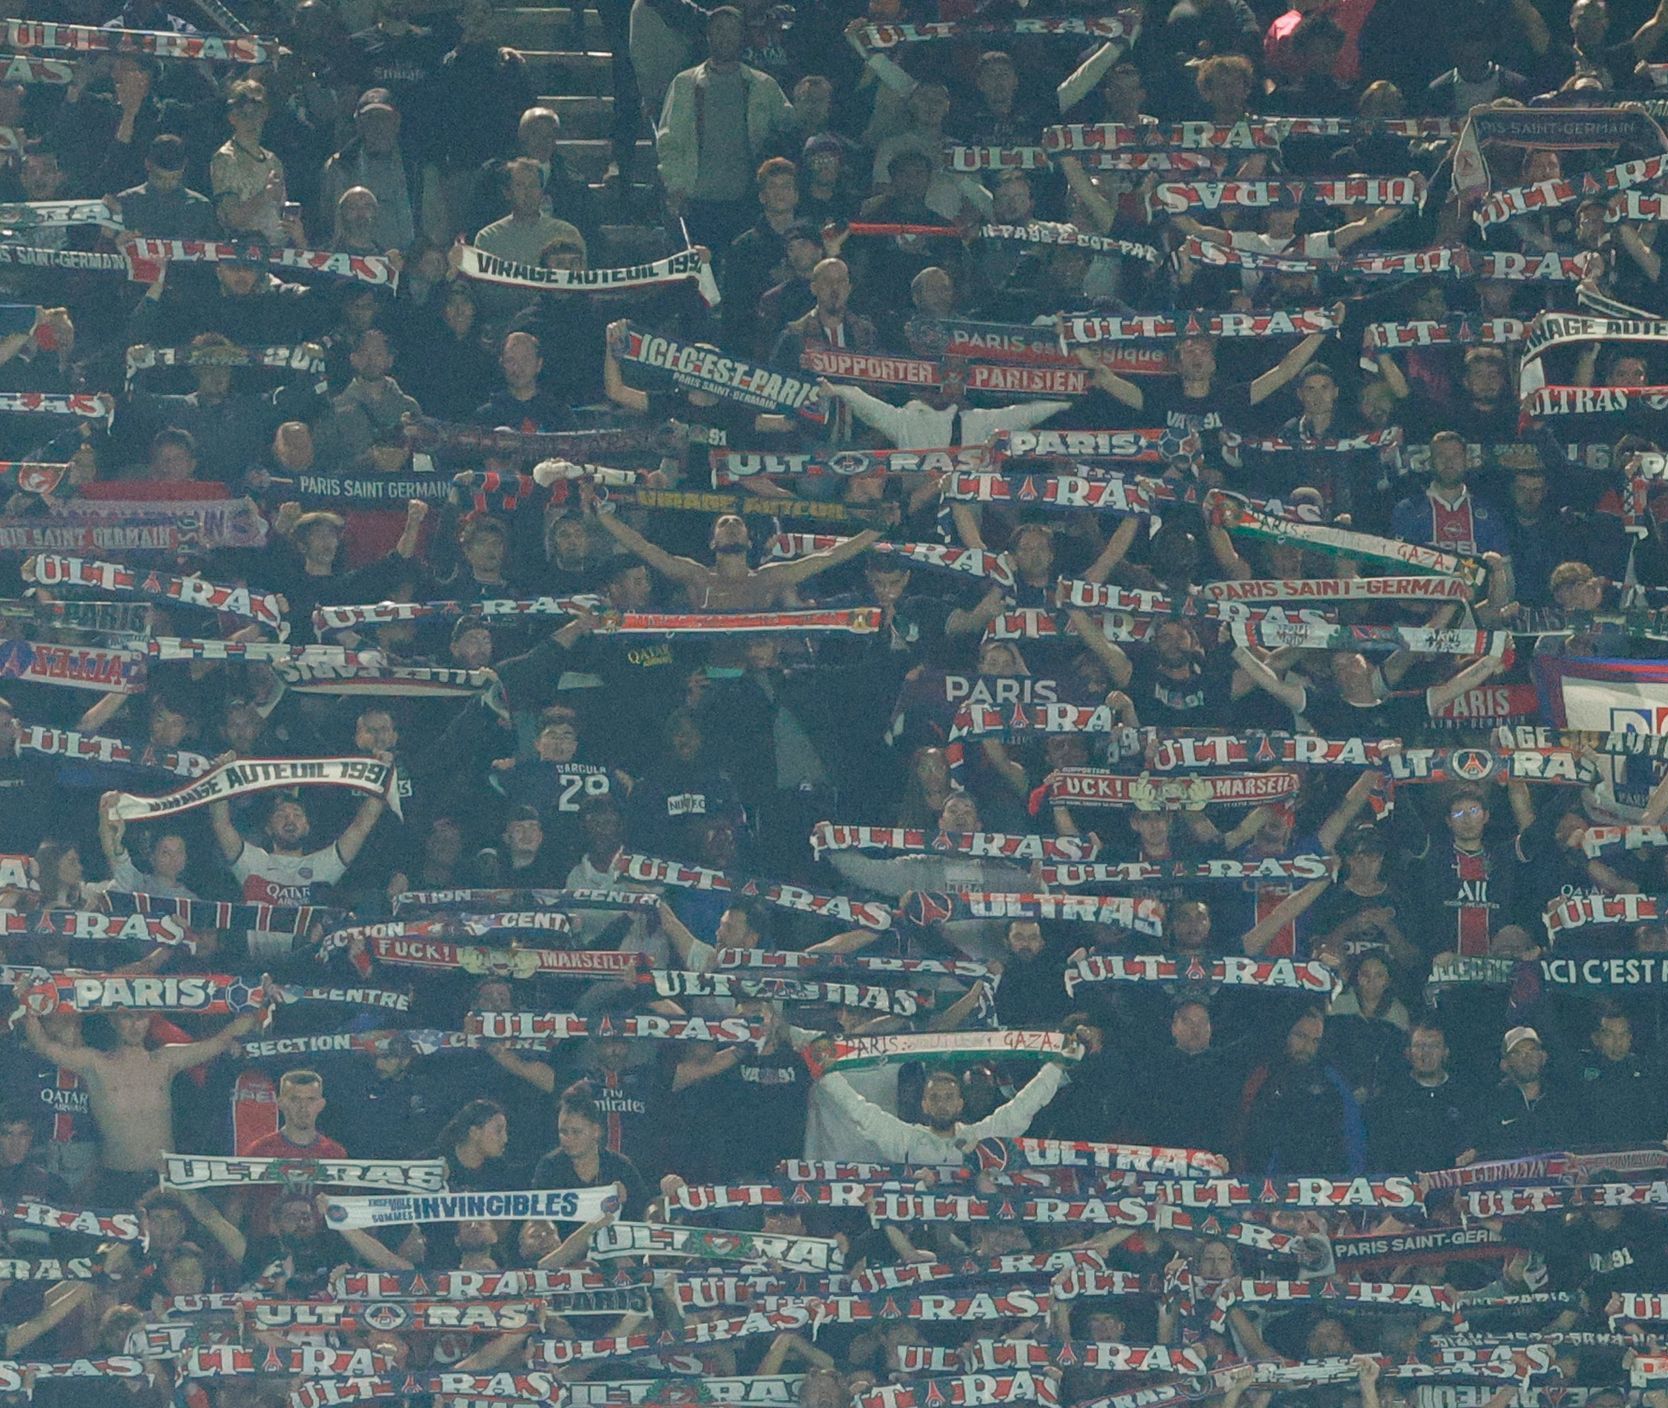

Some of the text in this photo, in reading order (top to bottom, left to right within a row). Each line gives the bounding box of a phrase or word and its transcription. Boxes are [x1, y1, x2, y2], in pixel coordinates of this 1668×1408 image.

[477, 257, 660, 286] VIRAGE AUTEUIL
[954, 330, 1025, 352] PARIS
[639, 336, 824, 408] ICI C'EST PARIS
[809, 352, 1084, 391] SUPPORTER PARISIEN
[1012, 432, 1139, 457] PARIS
[301, 476, 451, 499] PARIS SAINT GERMAIN
[1212, 578, 1466, 601] PARIS SAINT-GERMAIN
[946, 677, 1056, 703] PARIS
[226, 760, 330, 787] AUTEUIL
[378, 941, 452, 964] FUCK!
[1542, 961, 1653, 984] ICI C'EST
[78, 978, 208, 1008] PARIS
[247, 1035, 350, 1056] SECTION
[41, 1090, 88, 1104] QATAR
[413, 1192, 577, 1219] INVINCIBLES
[1336, 1242, 1388, 1259] PARIS
